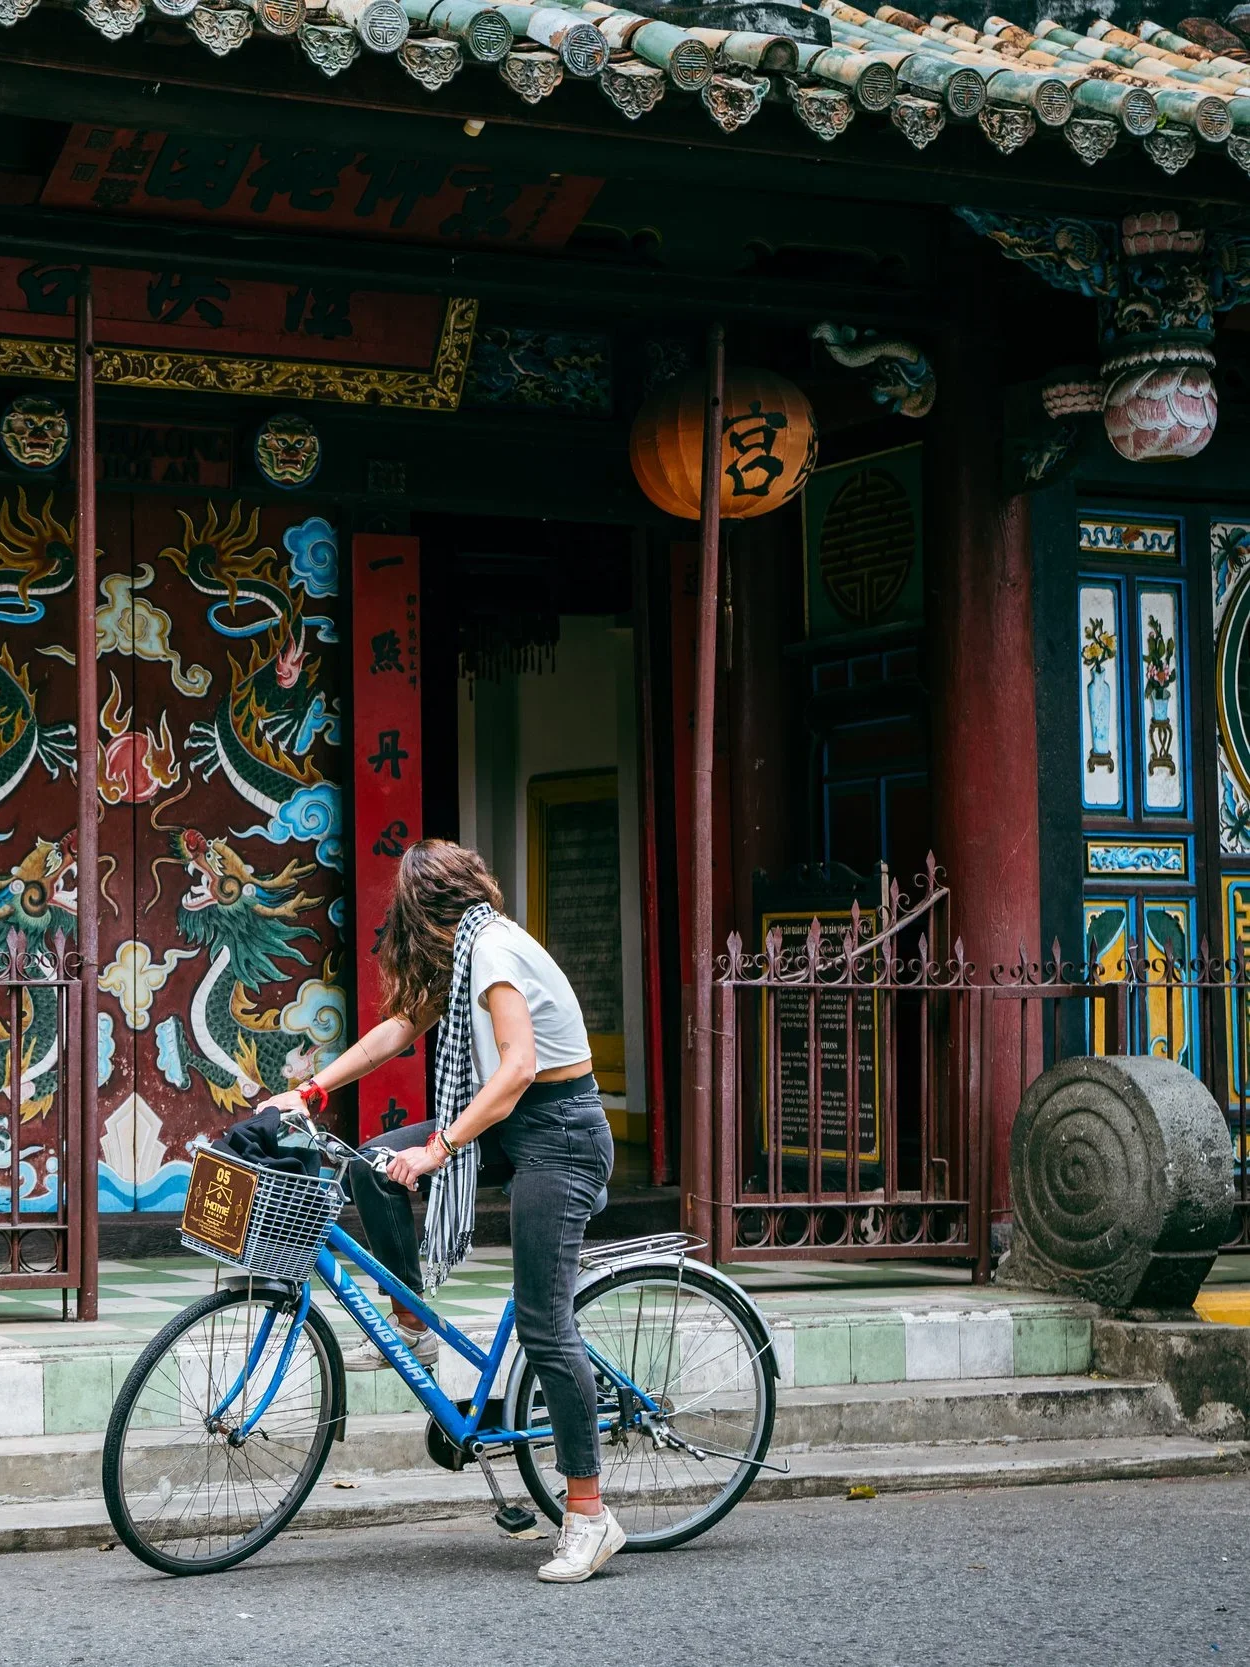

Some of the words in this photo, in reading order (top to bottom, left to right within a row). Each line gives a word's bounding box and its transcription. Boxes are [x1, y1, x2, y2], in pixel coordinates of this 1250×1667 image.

[723, 400, 788, 497] 宮
[216, 1167, 232, 1185] 05
[343, 1284, 397, 1343] THONG
[389, 1345, 436, 1391] NHAT
